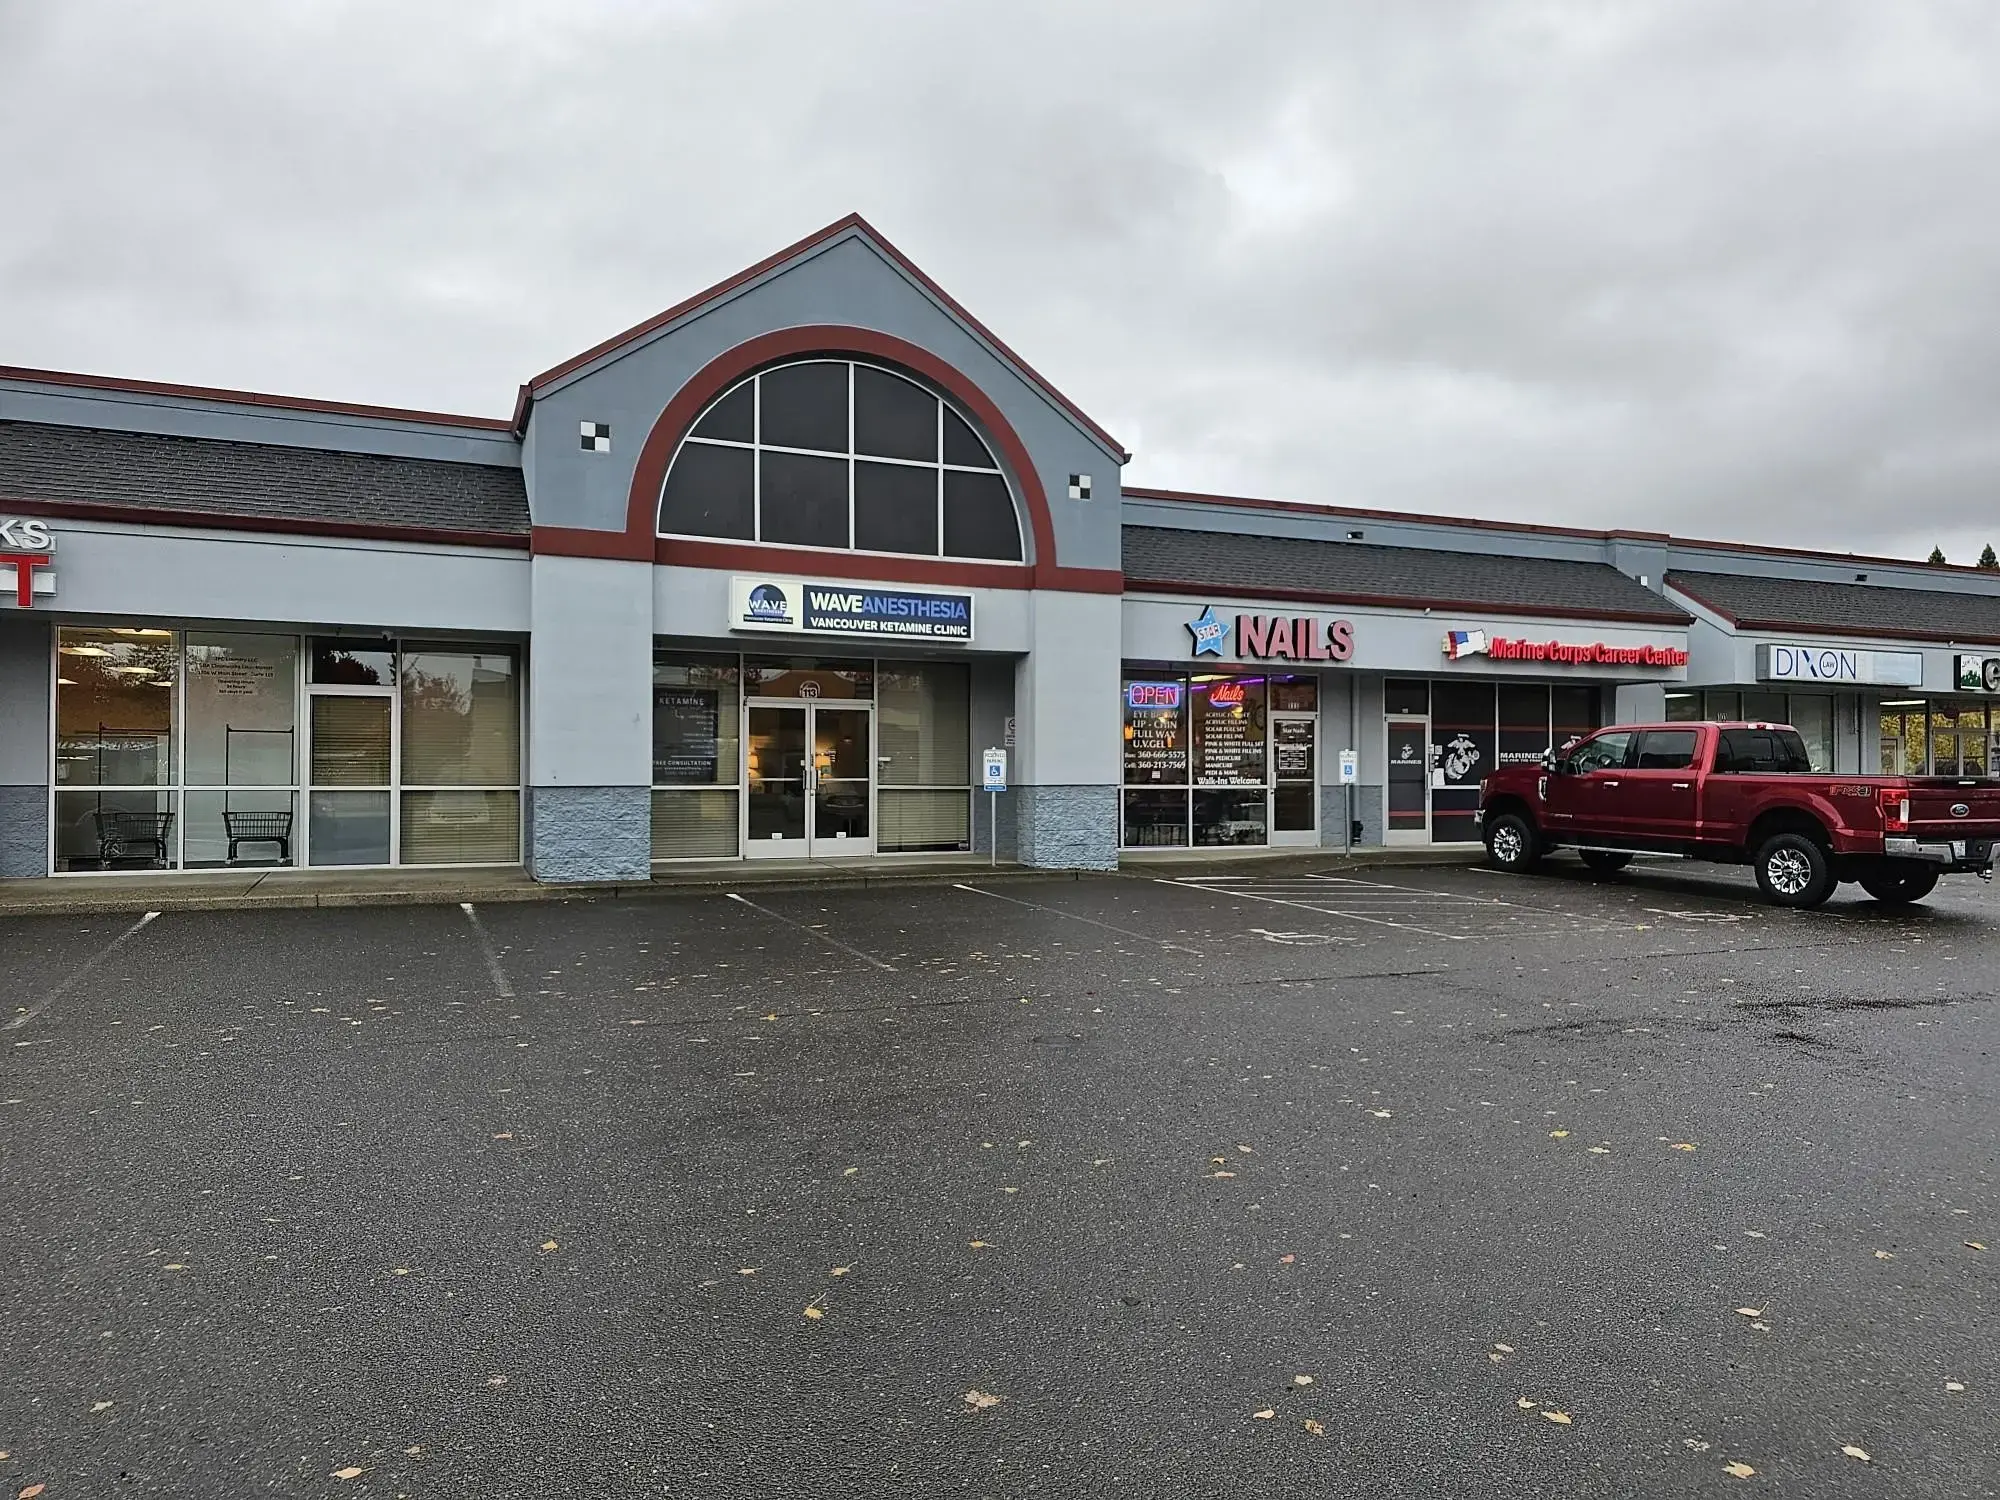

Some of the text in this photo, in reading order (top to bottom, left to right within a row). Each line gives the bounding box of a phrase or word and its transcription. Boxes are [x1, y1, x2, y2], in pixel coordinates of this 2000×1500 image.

[0, 519, 50, 549] KS
[749, 599, 788, 610] WAVE
[810, 616, 968, 636] VANCOUVER KETAMINE CLINIC
[1198, 623, 1221, 640] STAR
[1237, 614, 1354, 661] NAILS
[1491, 637, 1690, 666] Marine Corps Career Center
[1776, 648, 1857, 680] DIXON
[1822, 660, 1836, 668] LAW
[803, 688, 816, 698] 113
[1132, 685, 1178, 705] OPEN
[1211, 684, 1245, 701] Nails
[659, 697, 705, 706] KETAMINE
[1133, 720, 1146, 728] LIP
[1133, 730, 1176, 739] FULL WAX
[1132, 740, 1166, 748] U.V.GEL
[1137, 751, 1186, 759] 360-666-5575
[1137, 760, 1186, 769] 360-213-7569
[1197, 776, 1261, 785] Walk-Ins Welcome
